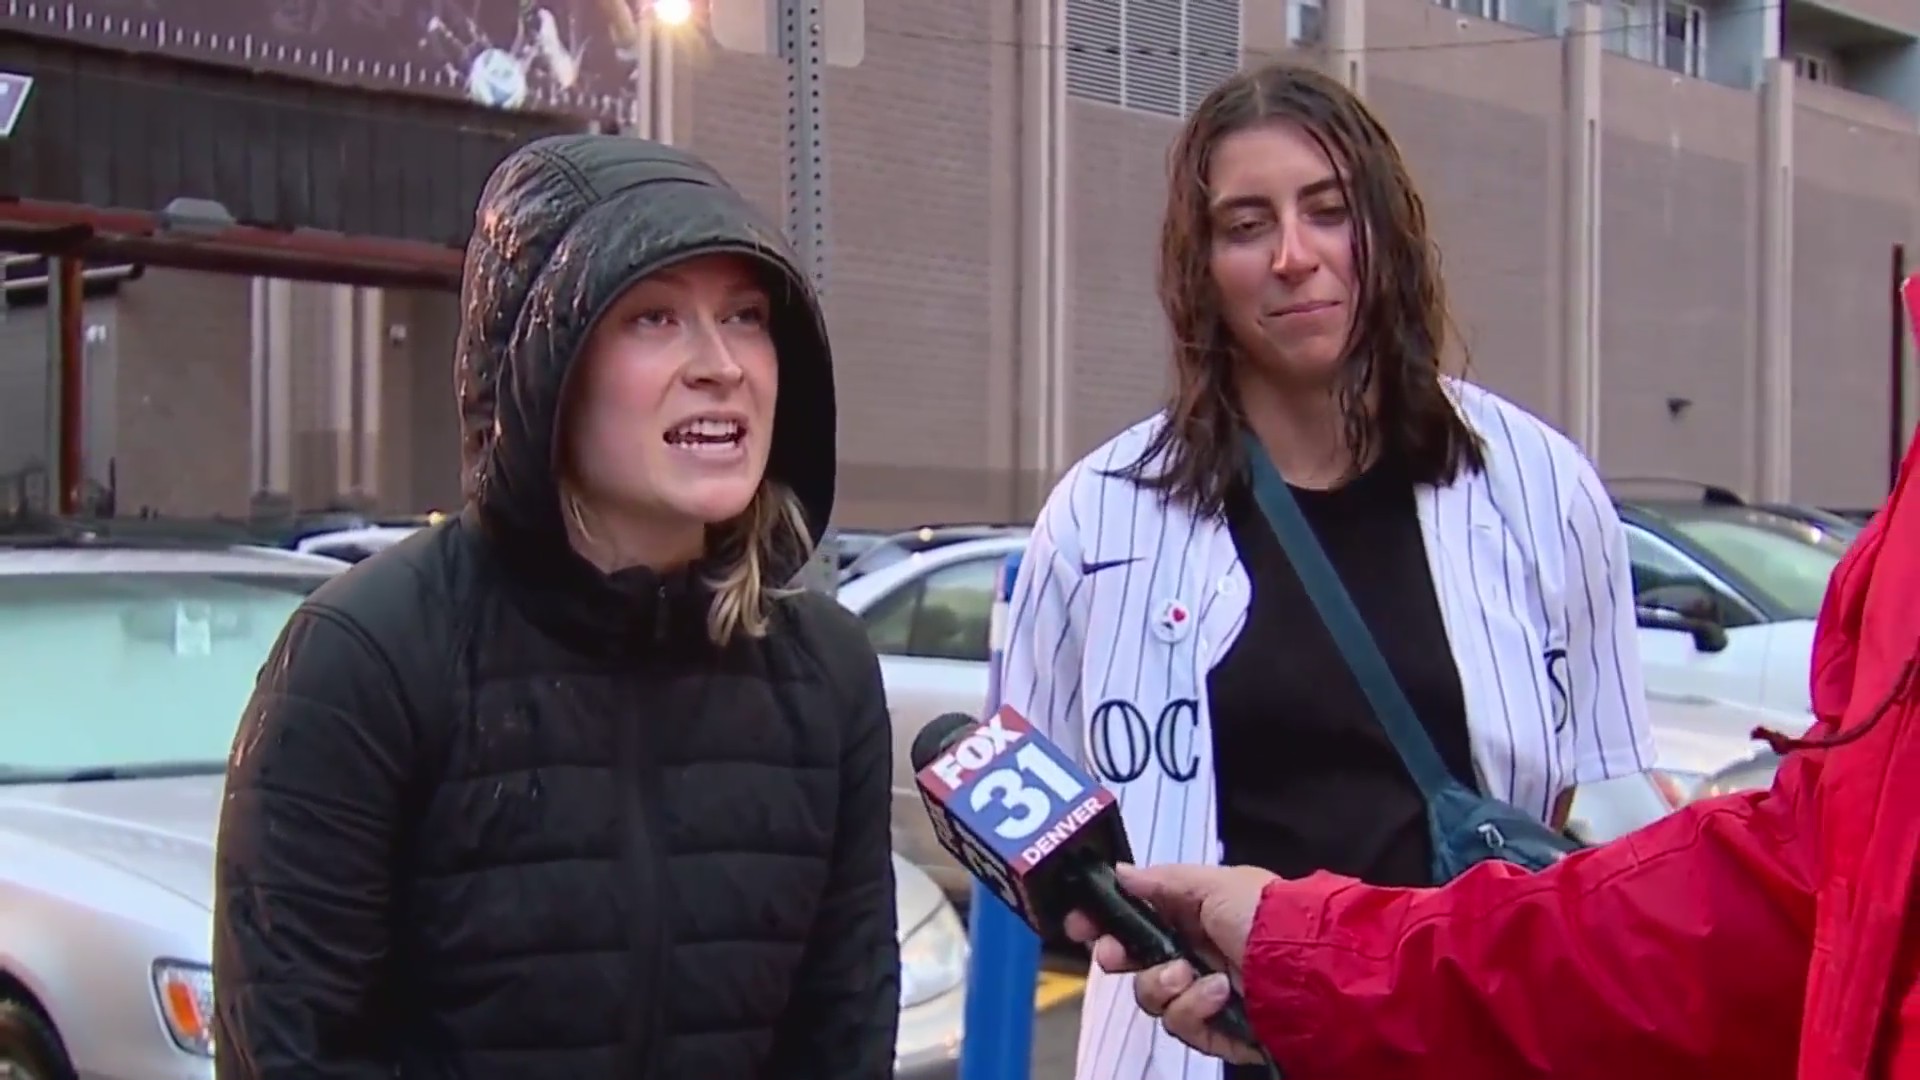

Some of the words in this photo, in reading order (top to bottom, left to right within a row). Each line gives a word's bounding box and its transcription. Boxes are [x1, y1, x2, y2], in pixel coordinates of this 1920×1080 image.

[932, 714, 1024, 790] FOX
[970, 742, 1084, 840] 31
[1022, 797, 1106, 867] DENVER
